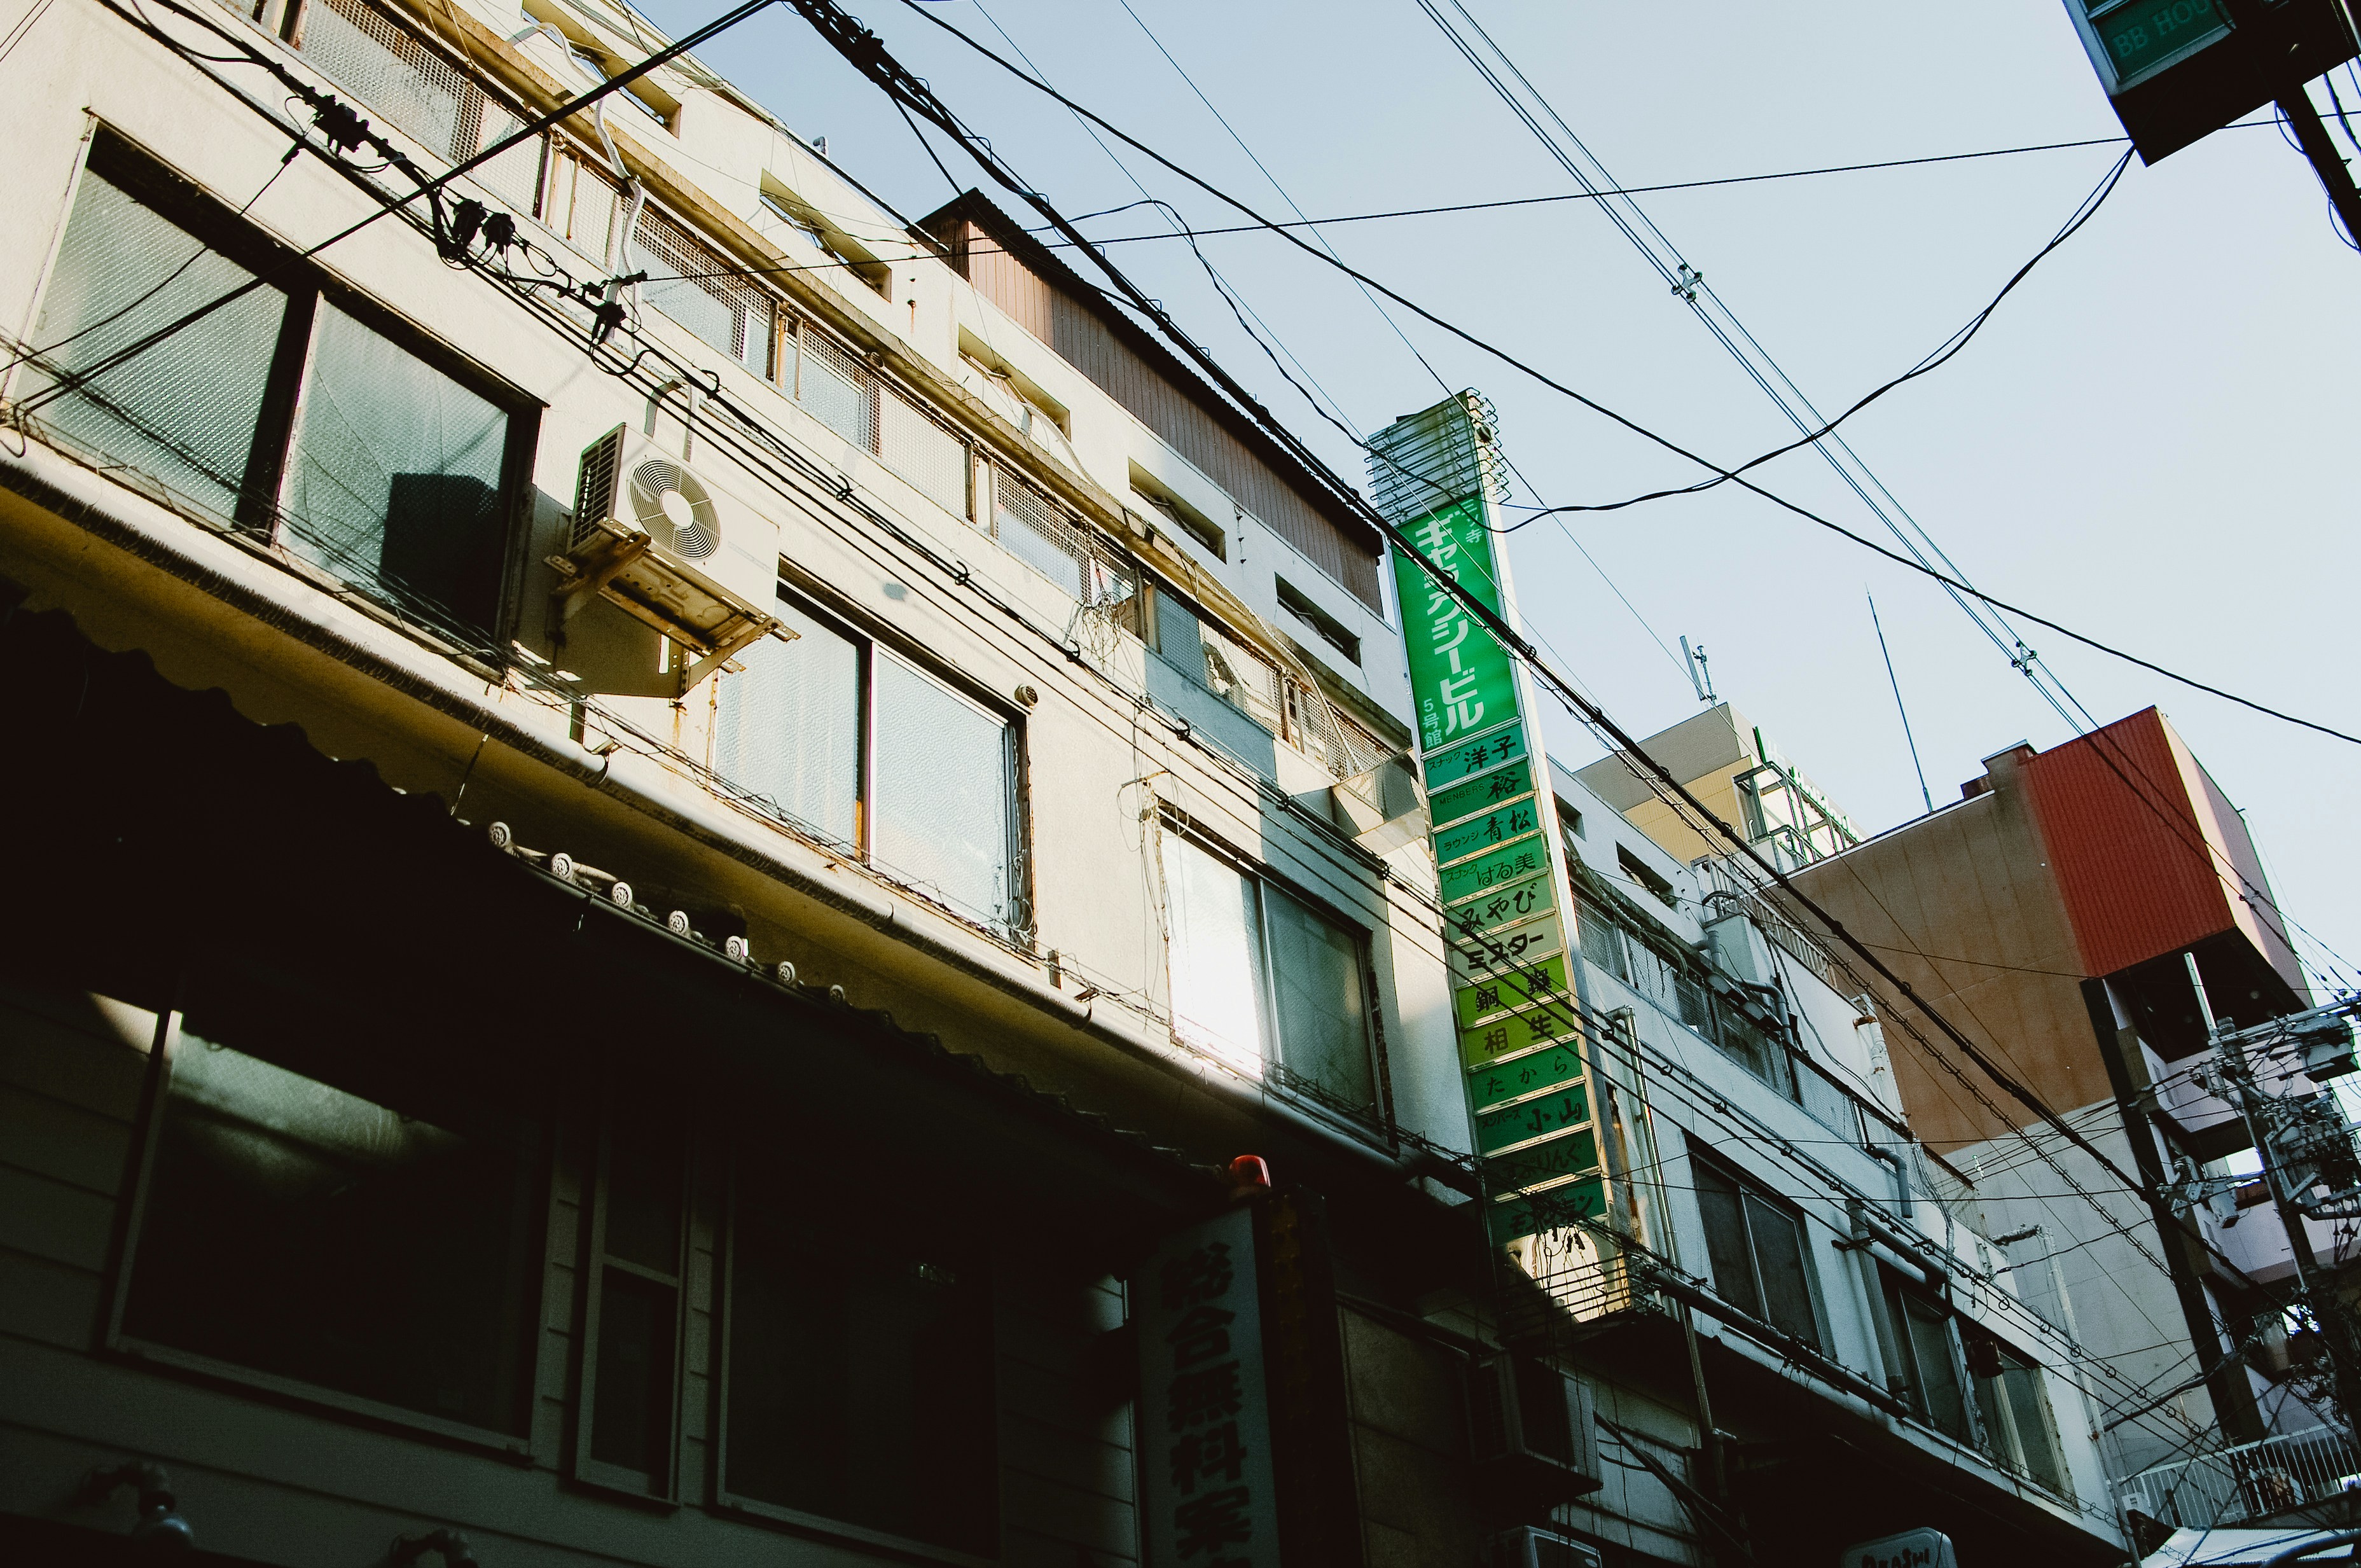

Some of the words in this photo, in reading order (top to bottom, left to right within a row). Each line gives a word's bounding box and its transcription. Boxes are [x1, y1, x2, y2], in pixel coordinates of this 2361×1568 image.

[2112, 25, 2148, 57] BB
[1423, 698, 1443, 749] 5号館
[1429, 751, 1462, 770] スナック
[1464, 735, 1516, 774] 洋子
[1443, 831, 1479, 851] ラウンジ
[1483, 809, 1531, 842] 青松
[1446, 863, 1478, 884] スナック
[1478, 852, 1536, 886] はる美
[1462, 882, 1537, 931] みやび
[1469, 933, 1544, 969] ミスター
[1484, 1014, 1554, 1054] 相生
[1486, 1056, 1567, 1096] たから
[1527, 1098, 1582, 1132] 小山
[1160, 1242, 1251, 1568] 総合無料案
